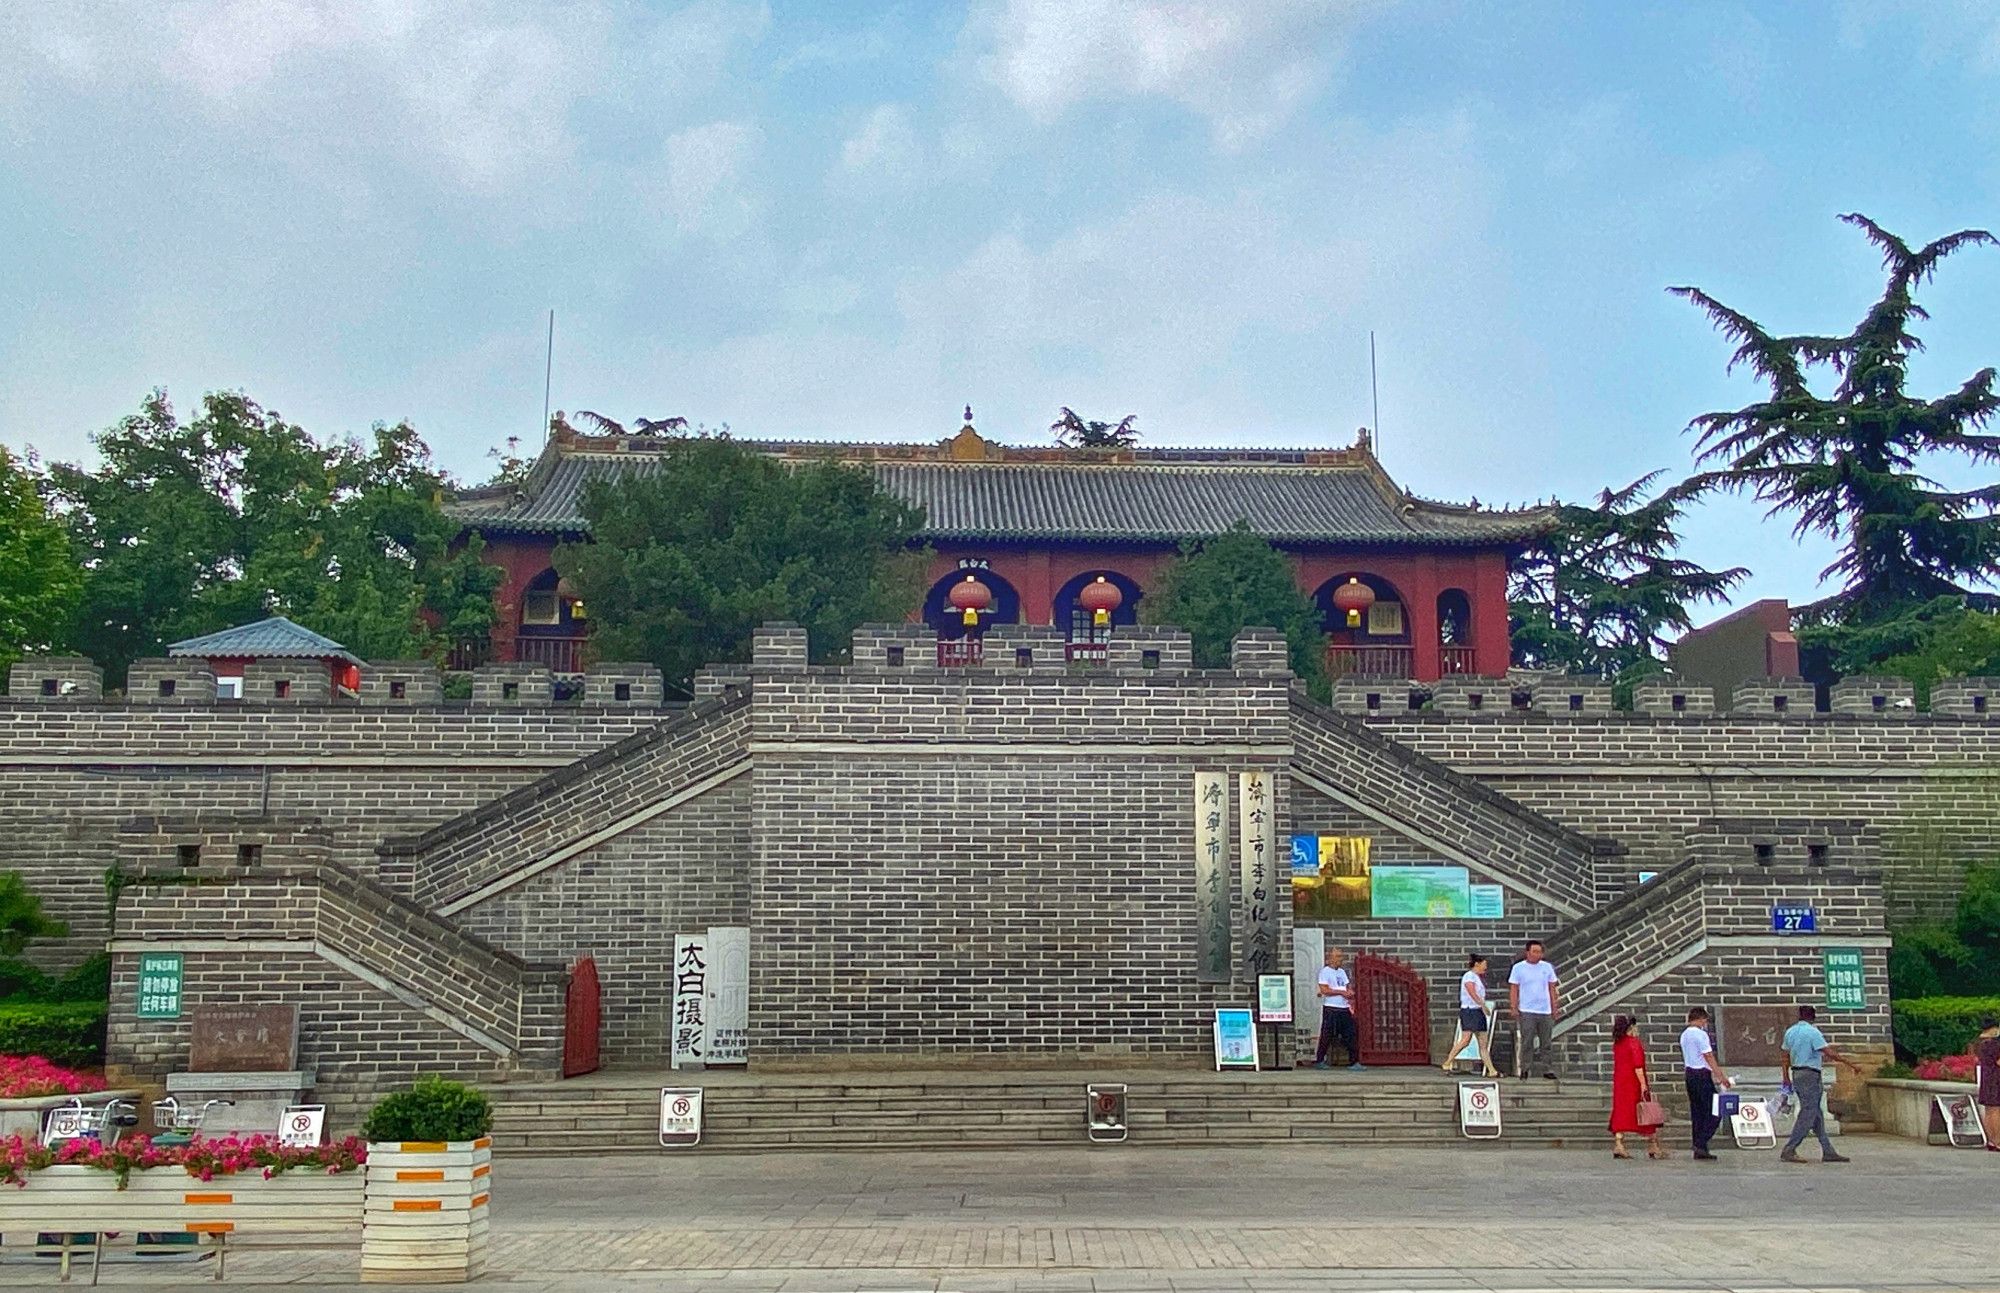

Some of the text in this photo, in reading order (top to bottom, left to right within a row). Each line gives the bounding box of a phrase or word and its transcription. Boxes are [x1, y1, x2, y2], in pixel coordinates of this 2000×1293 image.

[1784, 917, 1802, 929] 27
[676, 942, 706, 1057] 太白摄影
